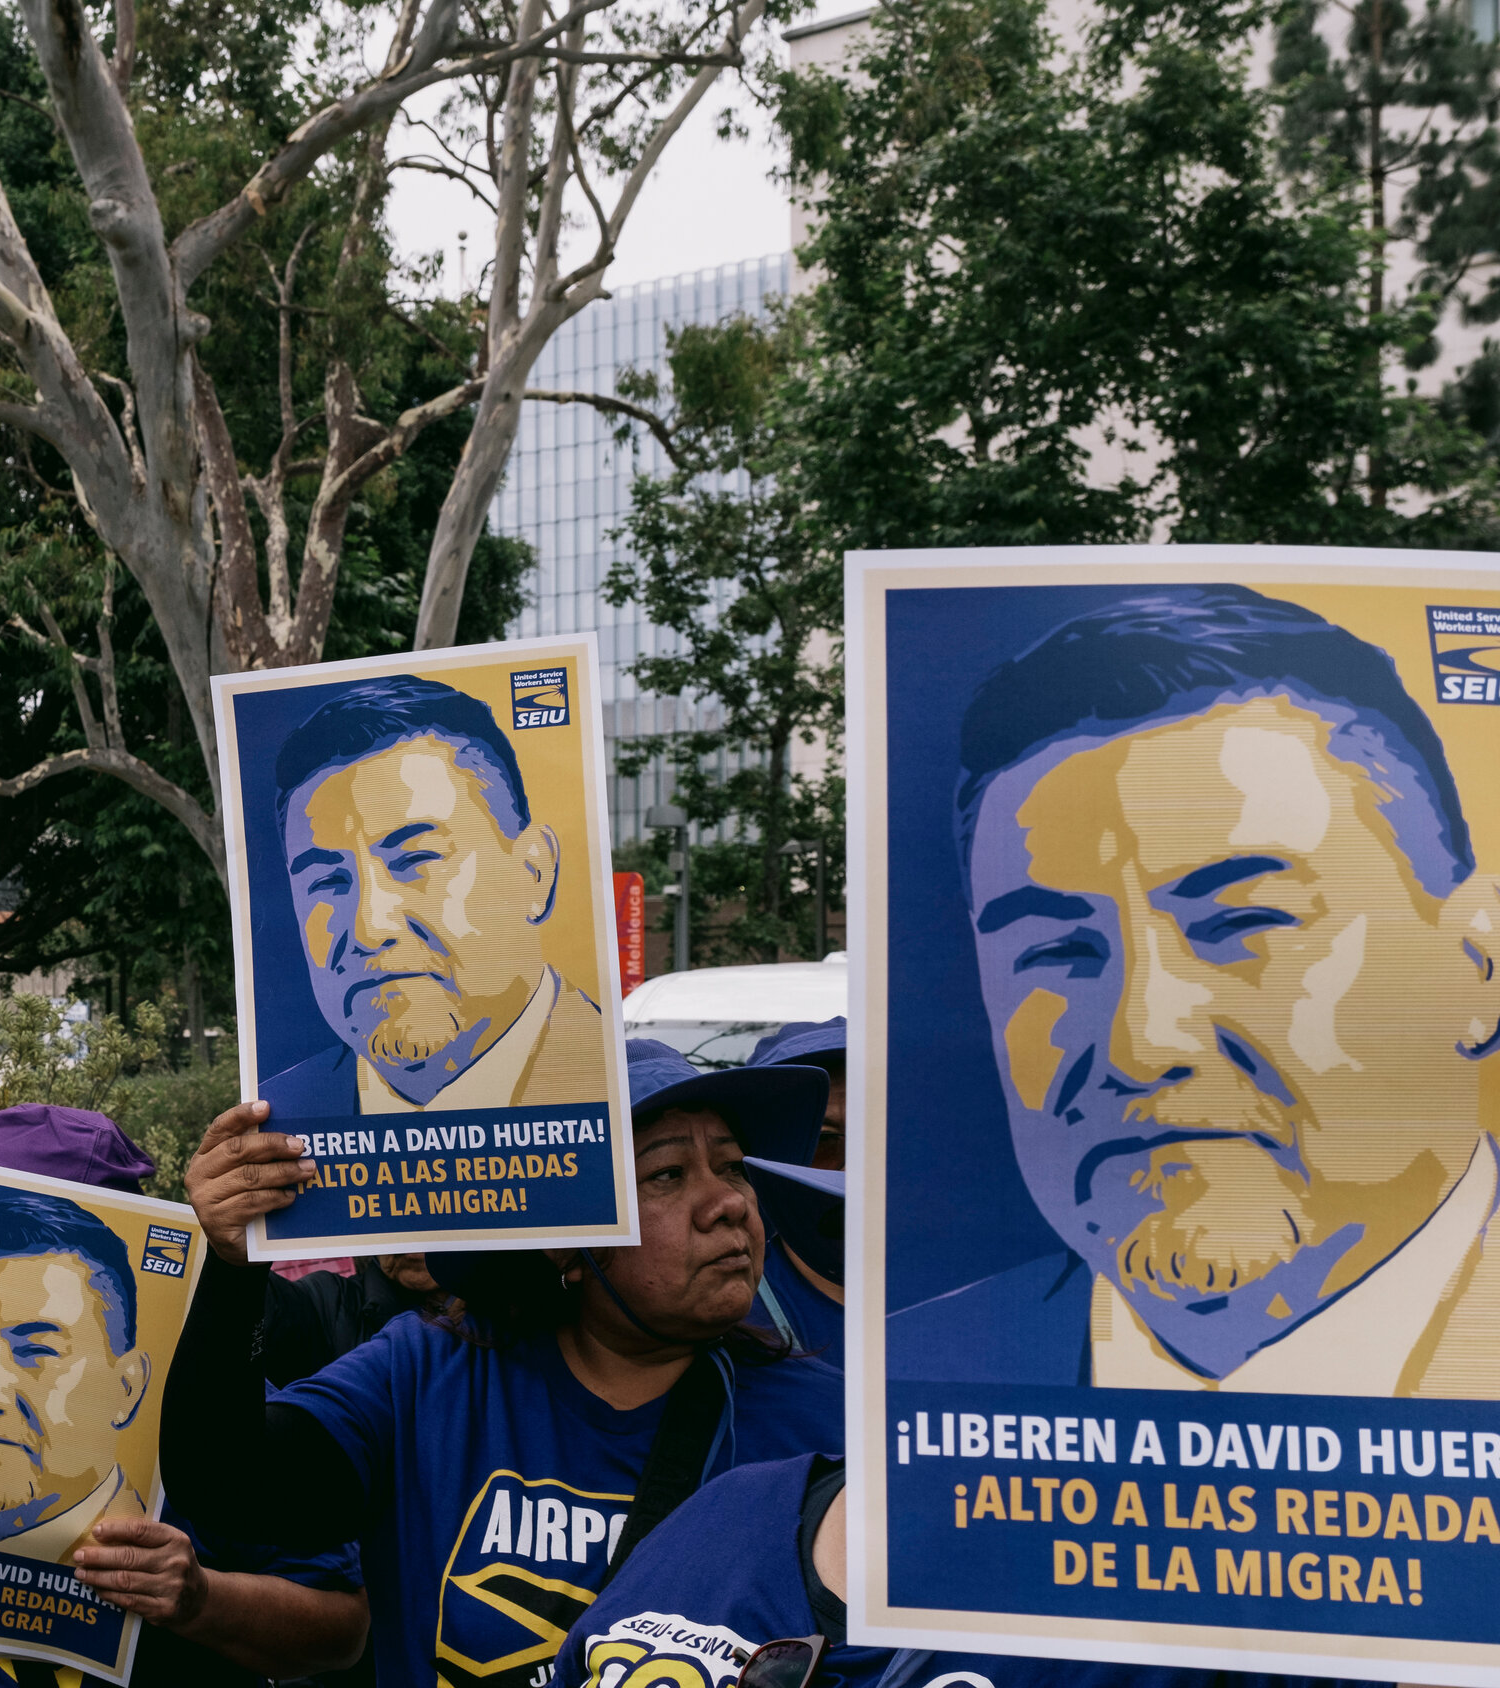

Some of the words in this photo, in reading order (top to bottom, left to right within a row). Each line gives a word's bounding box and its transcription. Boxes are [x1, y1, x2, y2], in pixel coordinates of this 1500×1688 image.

[1432, 610, 1473, 621] United
[1433, 621, 1482, 633] Workers
[514, 672, 537, 681] United
[1442, 676, 1500, 701] SEI
[516, 709, 566, 727] SEIU
[627, 885, 641, 975] Melaleuca
[293, 1130, 376, 1157] BEREN
[382, 1129, 401, 1153] A
[405, 1125, 486, 1152] DAVID
[493, 1118, 605, 1148] HUERTA!
[376, 1161, 395, 1185] A
[400, 1158, 447, 1184] LAS
[455, 1152, 579, 1182] REDADAS
[348, 1193, 382, 1219] DE
[389, 1192, 422, 1217] LA
[428, 1187, 527, 1215] MIGRA!
[151, 1227, 169, 1235] United
[143, 1259, 183, 1275] SEIU
[897, 1411, 1117, 1465] ¡LIBEREN
[1129, 1419, 1166, 1465] A
[1178, 1421, 1342, 1472] DAVID
[954, 1475, 1098, 1529] ¡ALTO
[1112, 1481, 1149, 1527] A
[1163, 1483, 1257, 1533] LAS
[1275, 1488, 1500, 1545] REDADA
[1053, 1540, 1118, 1588] DE
[1135, 1544, 1201, 1593] LA
[1215, 1548, 1423, 1606] MIGRA!
[1, 1586, 98, 1625] REDADAS
[37, 1571, 122, 1613] HUER
